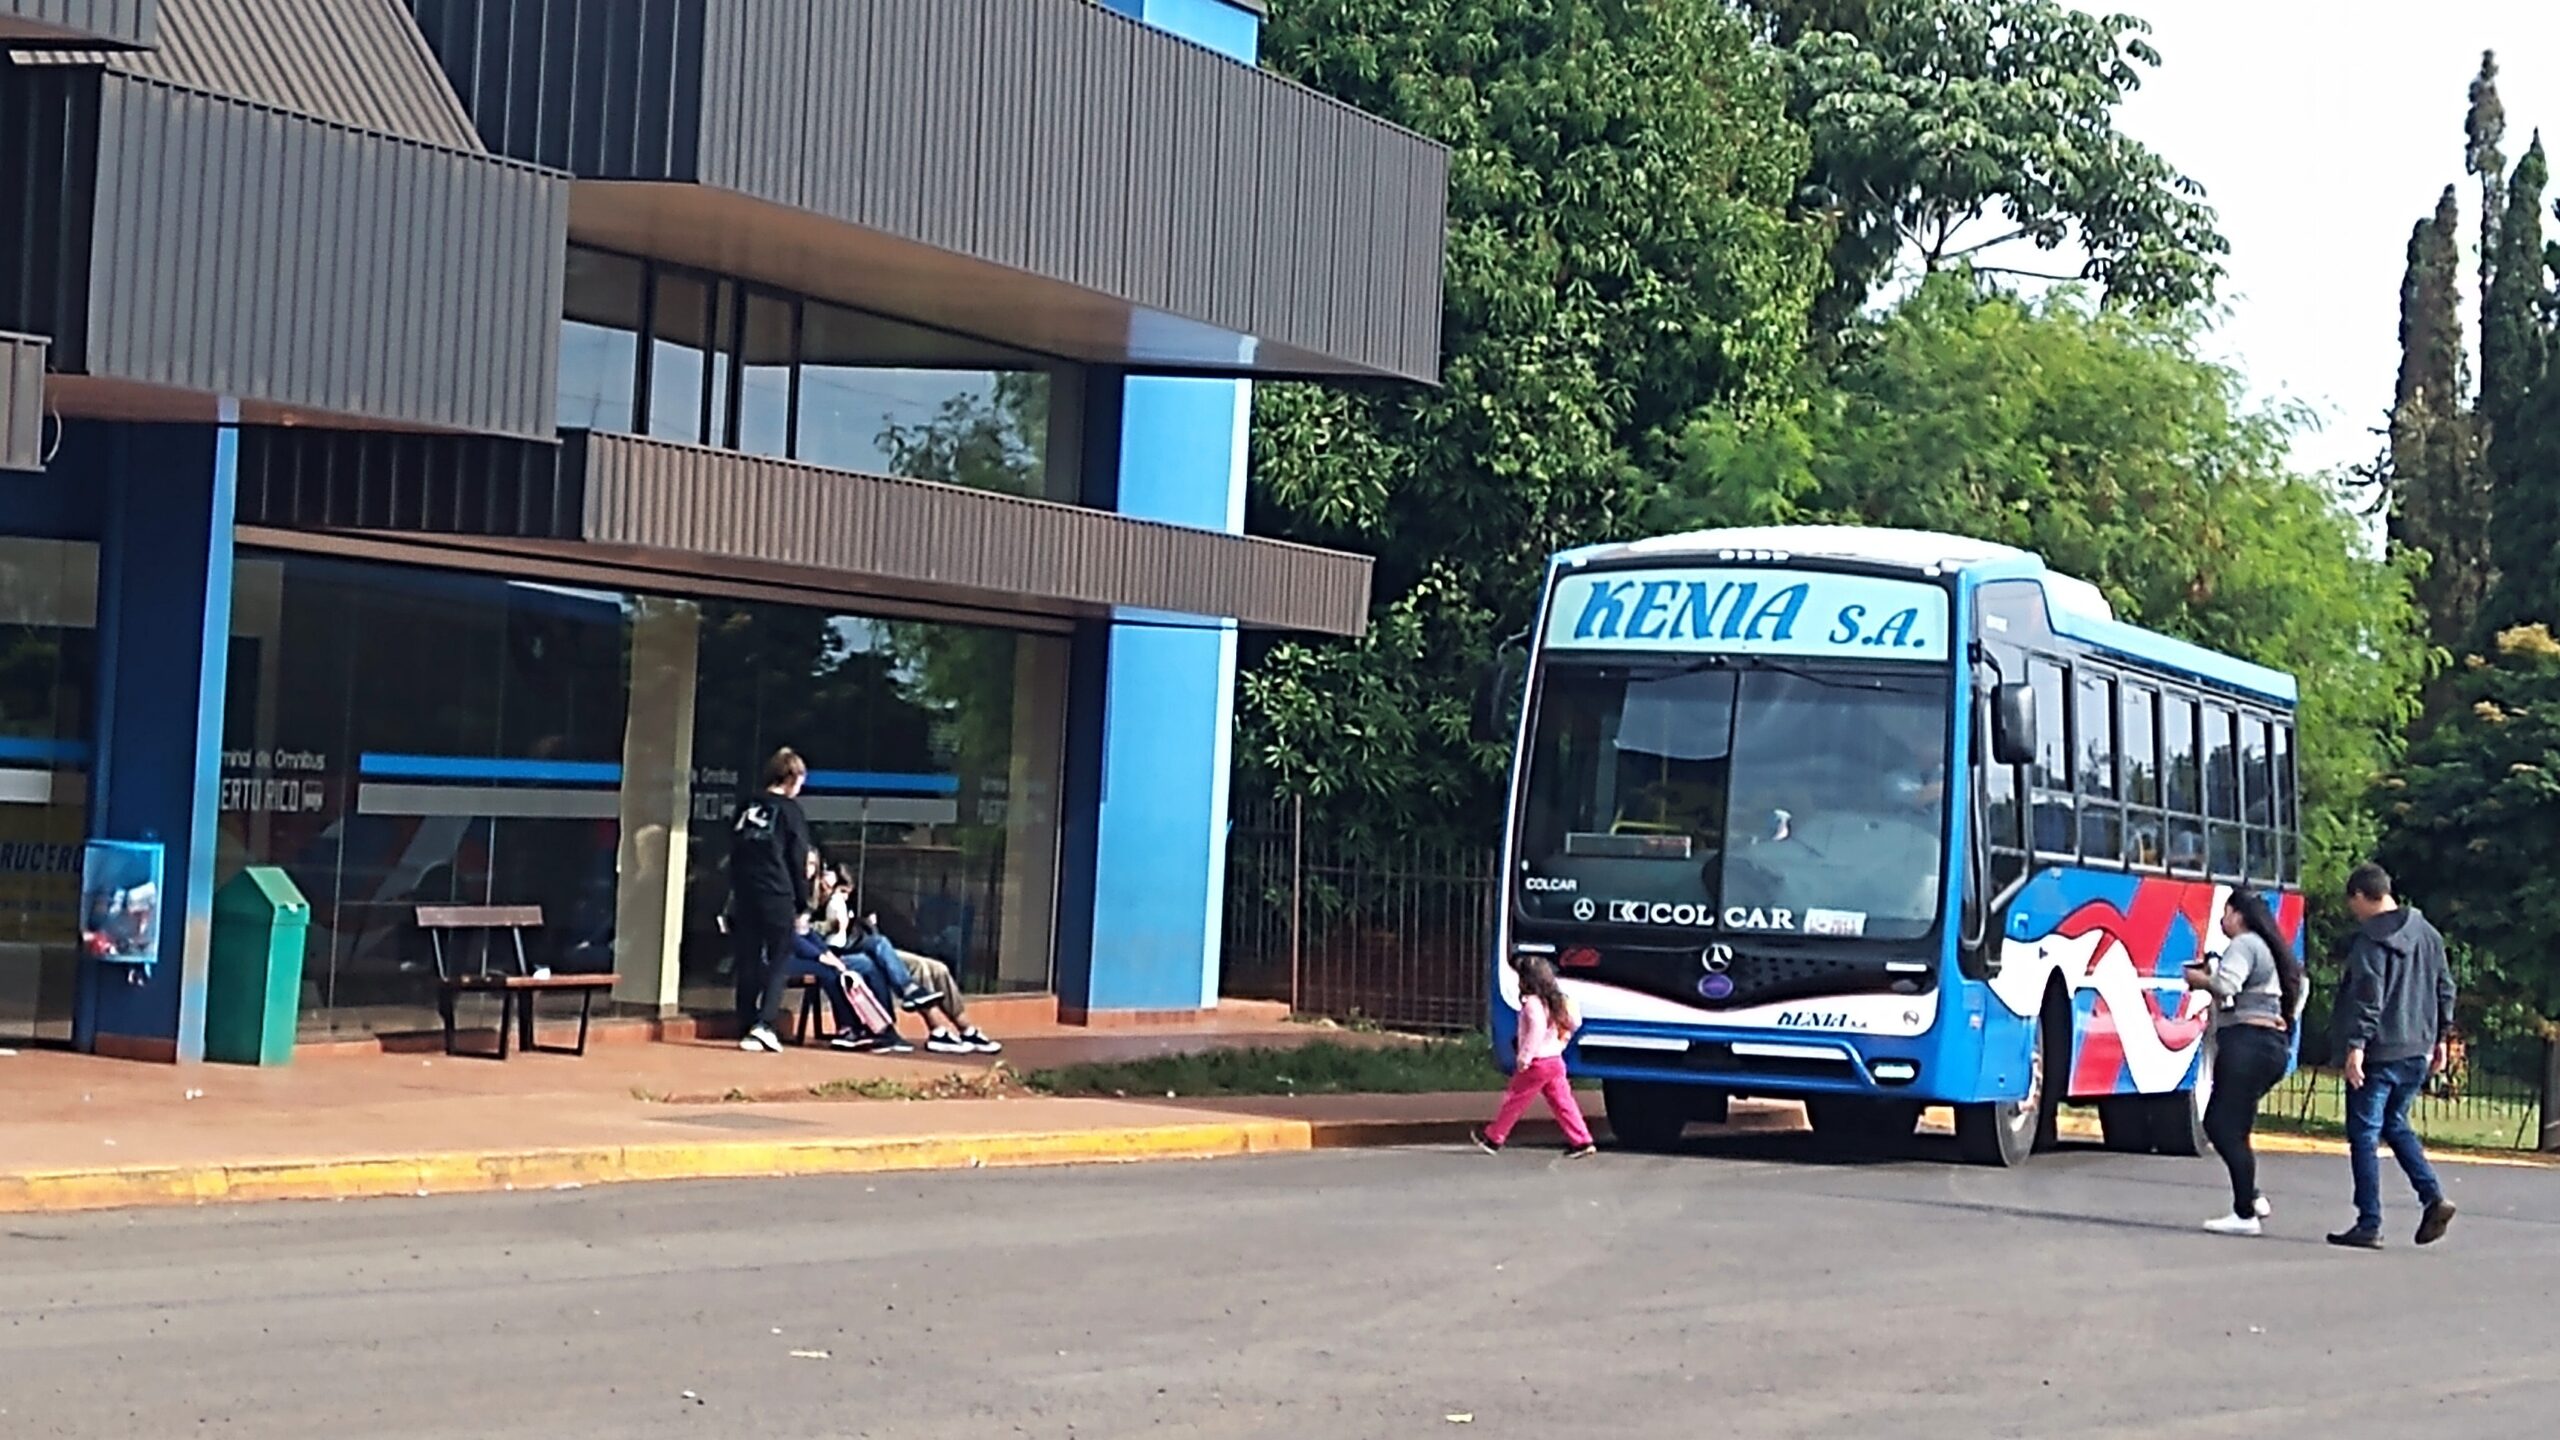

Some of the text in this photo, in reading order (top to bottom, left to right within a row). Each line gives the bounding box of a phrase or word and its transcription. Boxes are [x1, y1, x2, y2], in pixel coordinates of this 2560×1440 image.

[1573, 580, 1925, 648] KENIA S.A.
[264, 778, 300, 812] RICO
[1525, 877, 1578, 892] COLCAR
[1650, 903, 1715, 926] COL
[1723, 906, 1795, 930] CAR
